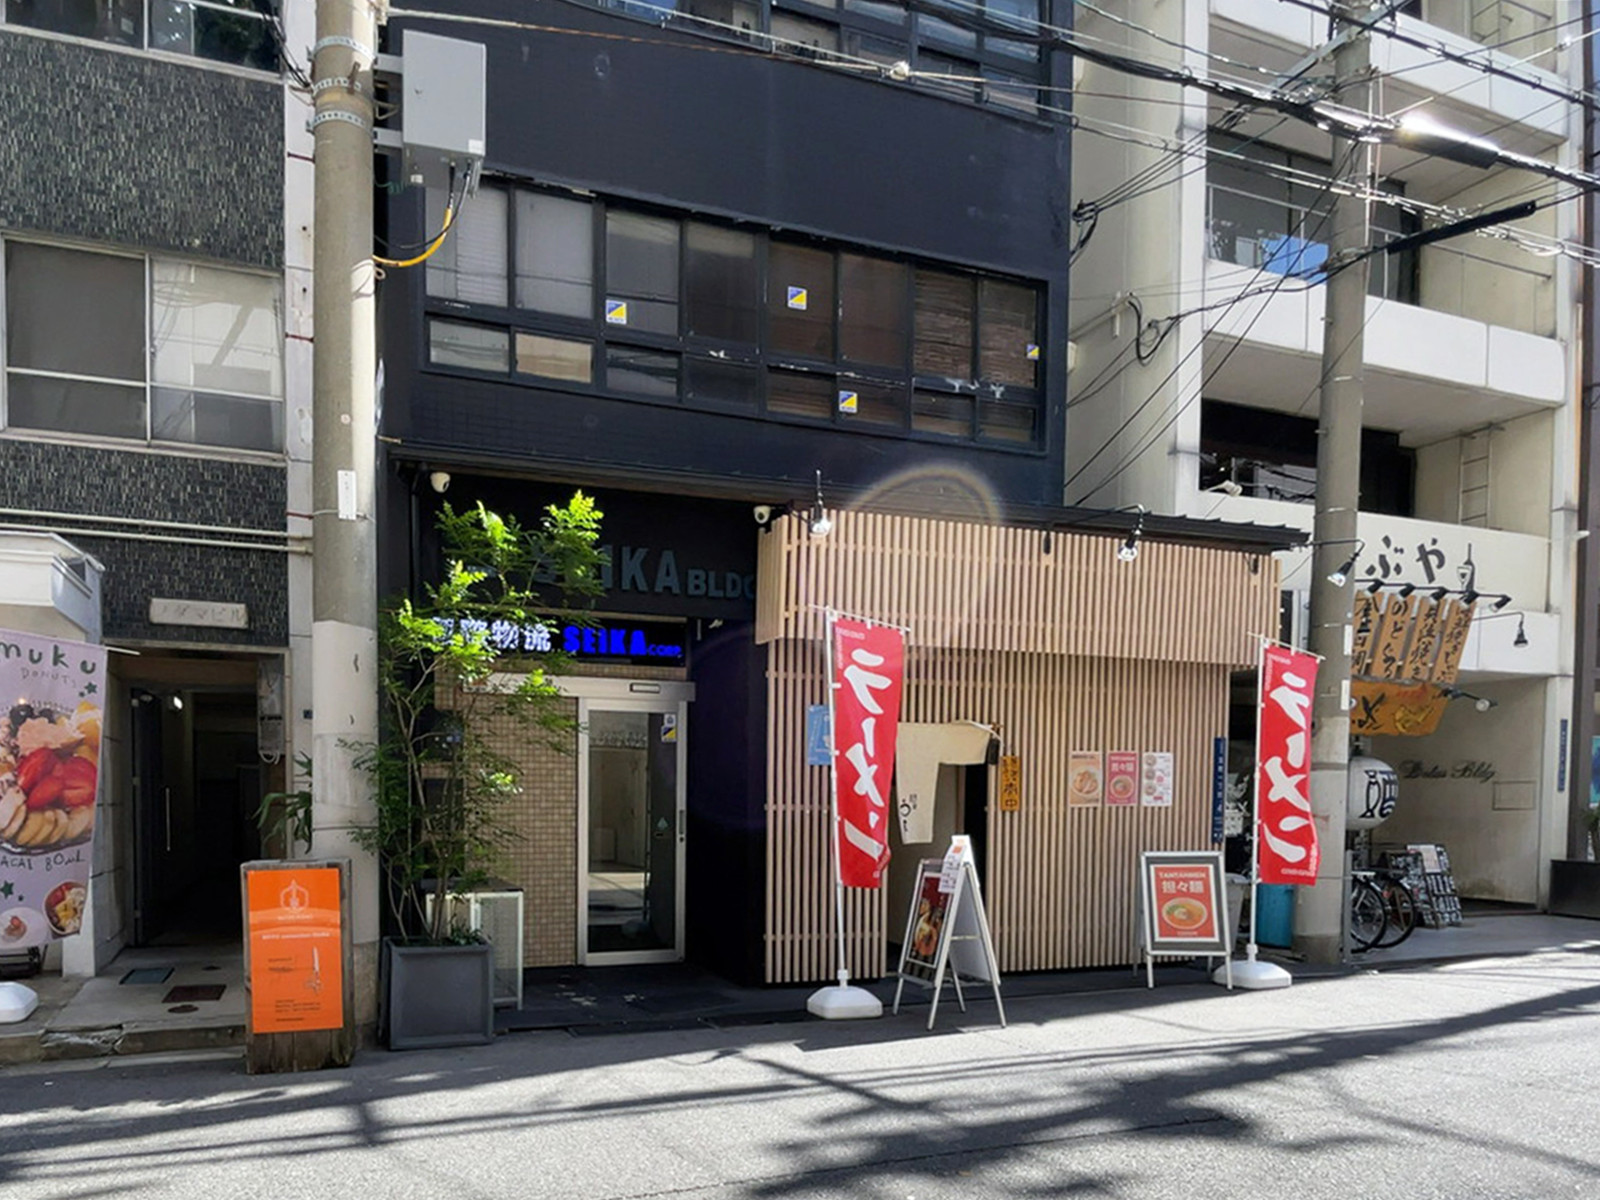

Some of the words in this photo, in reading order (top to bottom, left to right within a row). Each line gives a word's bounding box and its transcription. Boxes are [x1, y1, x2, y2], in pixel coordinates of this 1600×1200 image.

[562, 625, 647, 656] SEIKA
[843, 648, 893, 862] ラーメン
[1263, 671, 1311, 864] ラーメン
